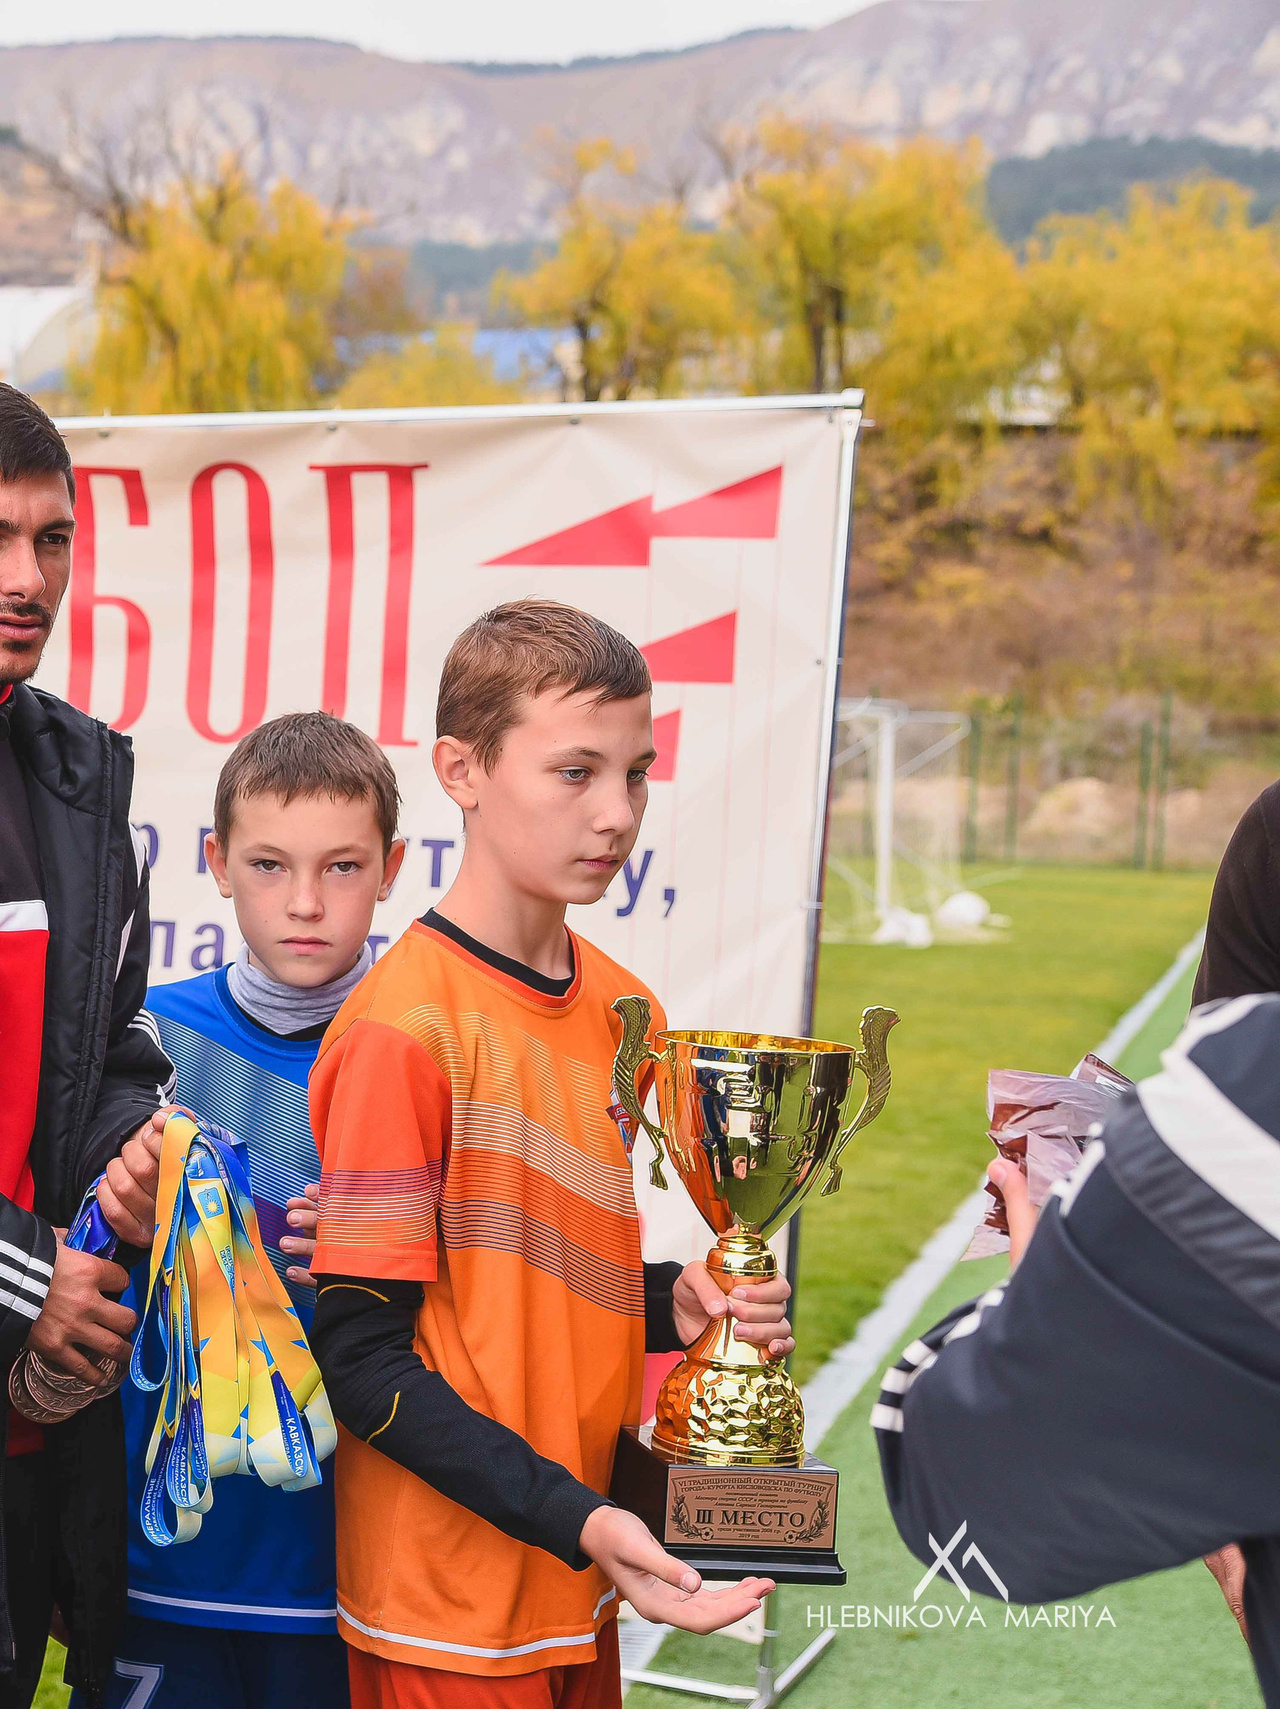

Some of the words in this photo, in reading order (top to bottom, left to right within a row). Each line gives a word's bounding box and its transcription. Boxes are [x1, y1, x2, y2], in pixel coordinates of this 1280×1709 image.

[689, 1477, 752, 1486] ТРАДИЦИОННЫЙ
[753, 1478, 796, 1487] ОТКРЫТЫЙ
[797, 1481, 827, 1492] ТУРНИР
[794, 1488, 823, 1497] ФУТБОЛУ
[695, 1509, 714, 1524] III
[720, 1510, 805, 1527] МЕСТО
